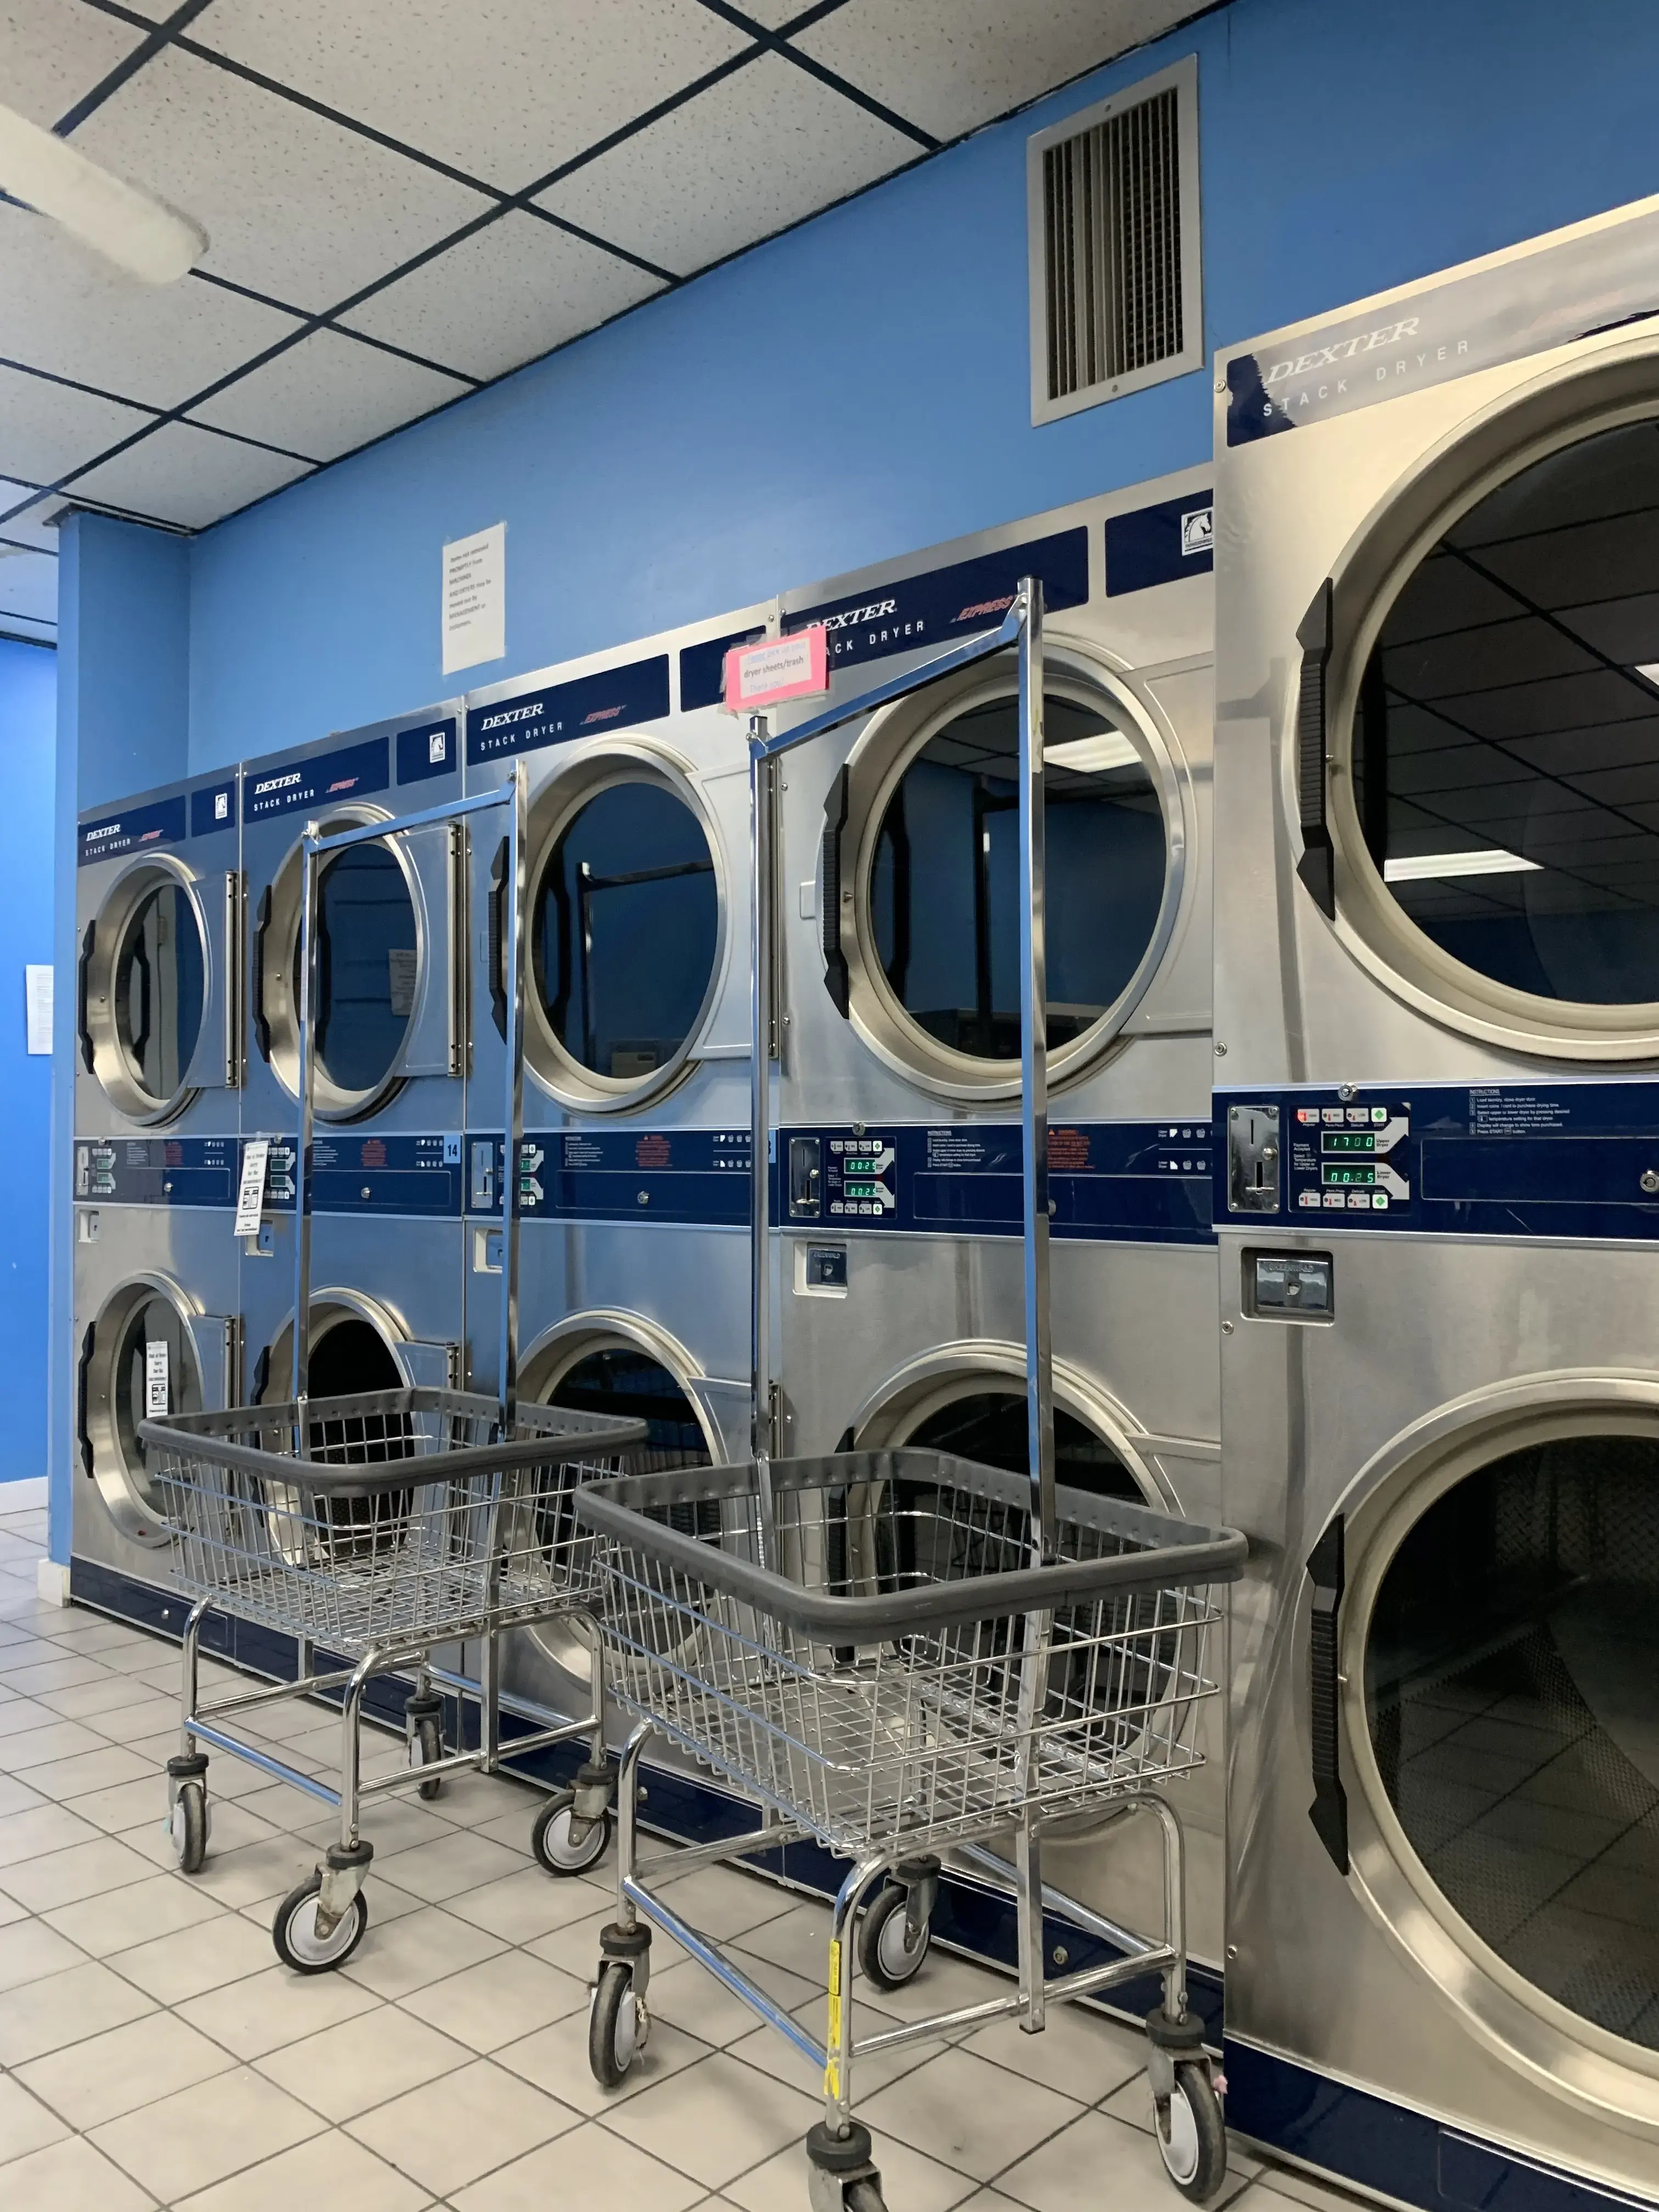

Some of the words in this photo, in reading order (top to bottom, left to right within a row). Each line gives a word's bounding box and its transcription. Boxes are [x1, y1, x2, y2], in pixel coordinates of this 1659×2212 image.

[1263, 317, 1420, 385] DEXTER
[1263, 380, 1348, 417] STACK
[1376, 340, 1469, 381] DRYER
[956, 595, 1014, 621] EXPRESS
[826, 640, 853, 656] ACK
[870, 620, 924, 645] DRYER
[744, 668, 761, 679] dryer
[763, 656, 804, 673] sheets/trash
[481, 703, 544, 731] DEXTER
[481, 734, 515, 751] STACK
[525, 721, 563, 740] DRYER
[254, 772, 301, 795] DEXTER
[254, 797, 280, 811] STACK
[286, 789, 314, 803] DRYER
[86, 824, 121, 842] DEXTER
[85, 845, 105, 856] STACK
[110, 838, 131, 850] DRYER
[447, 1144, 458, 1157] 14
